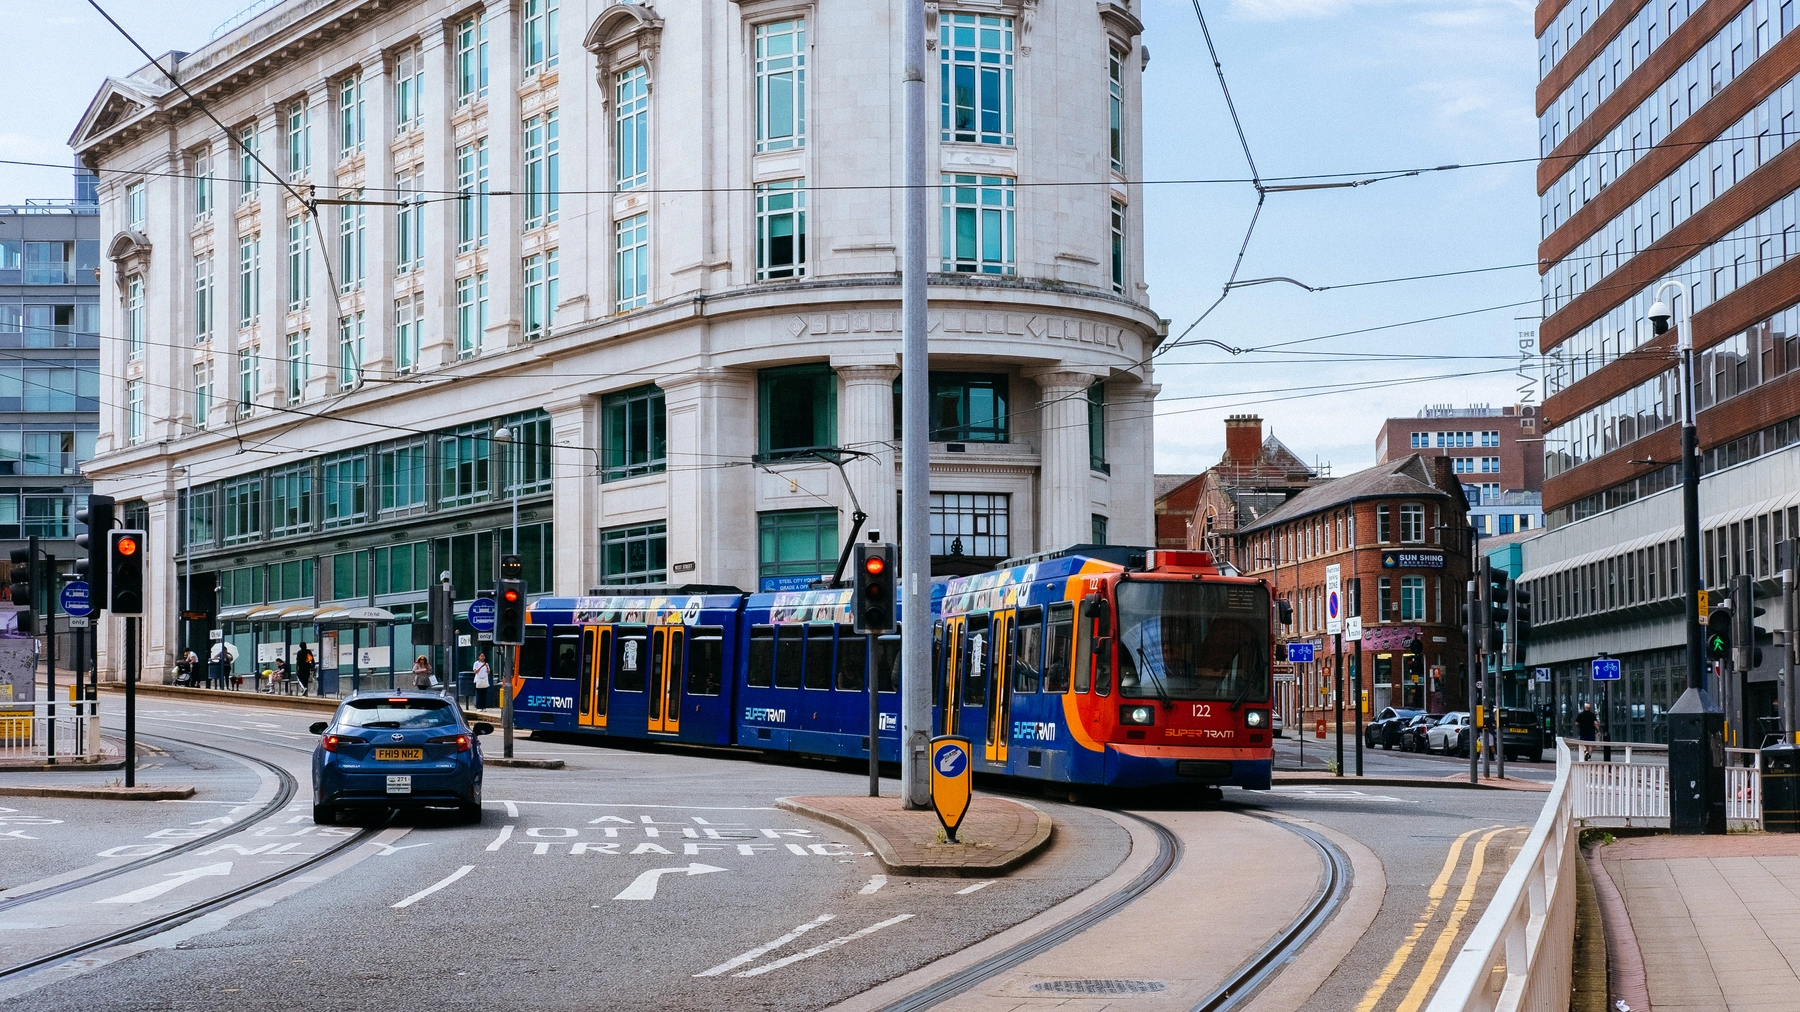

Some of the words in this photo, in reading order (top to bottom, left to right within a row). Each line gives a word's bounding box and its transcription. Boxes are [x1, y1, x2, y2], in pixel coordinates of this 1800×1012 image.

[1090, 577, 1099, 590] 122
[528, 695, 573, 709] SUPERTRAM
[745, 707, 786, 723] SUPERTRAM
[1192, 704, 1211, 717] 122
[379, 749, 399, 758] FH19
[401, 749, 419, 758] NHZ
[587, 815, 744, 826] ALL
[525, 826, 820, 840] OTHER
[518, 840, 855, 857] TRAFFIC
